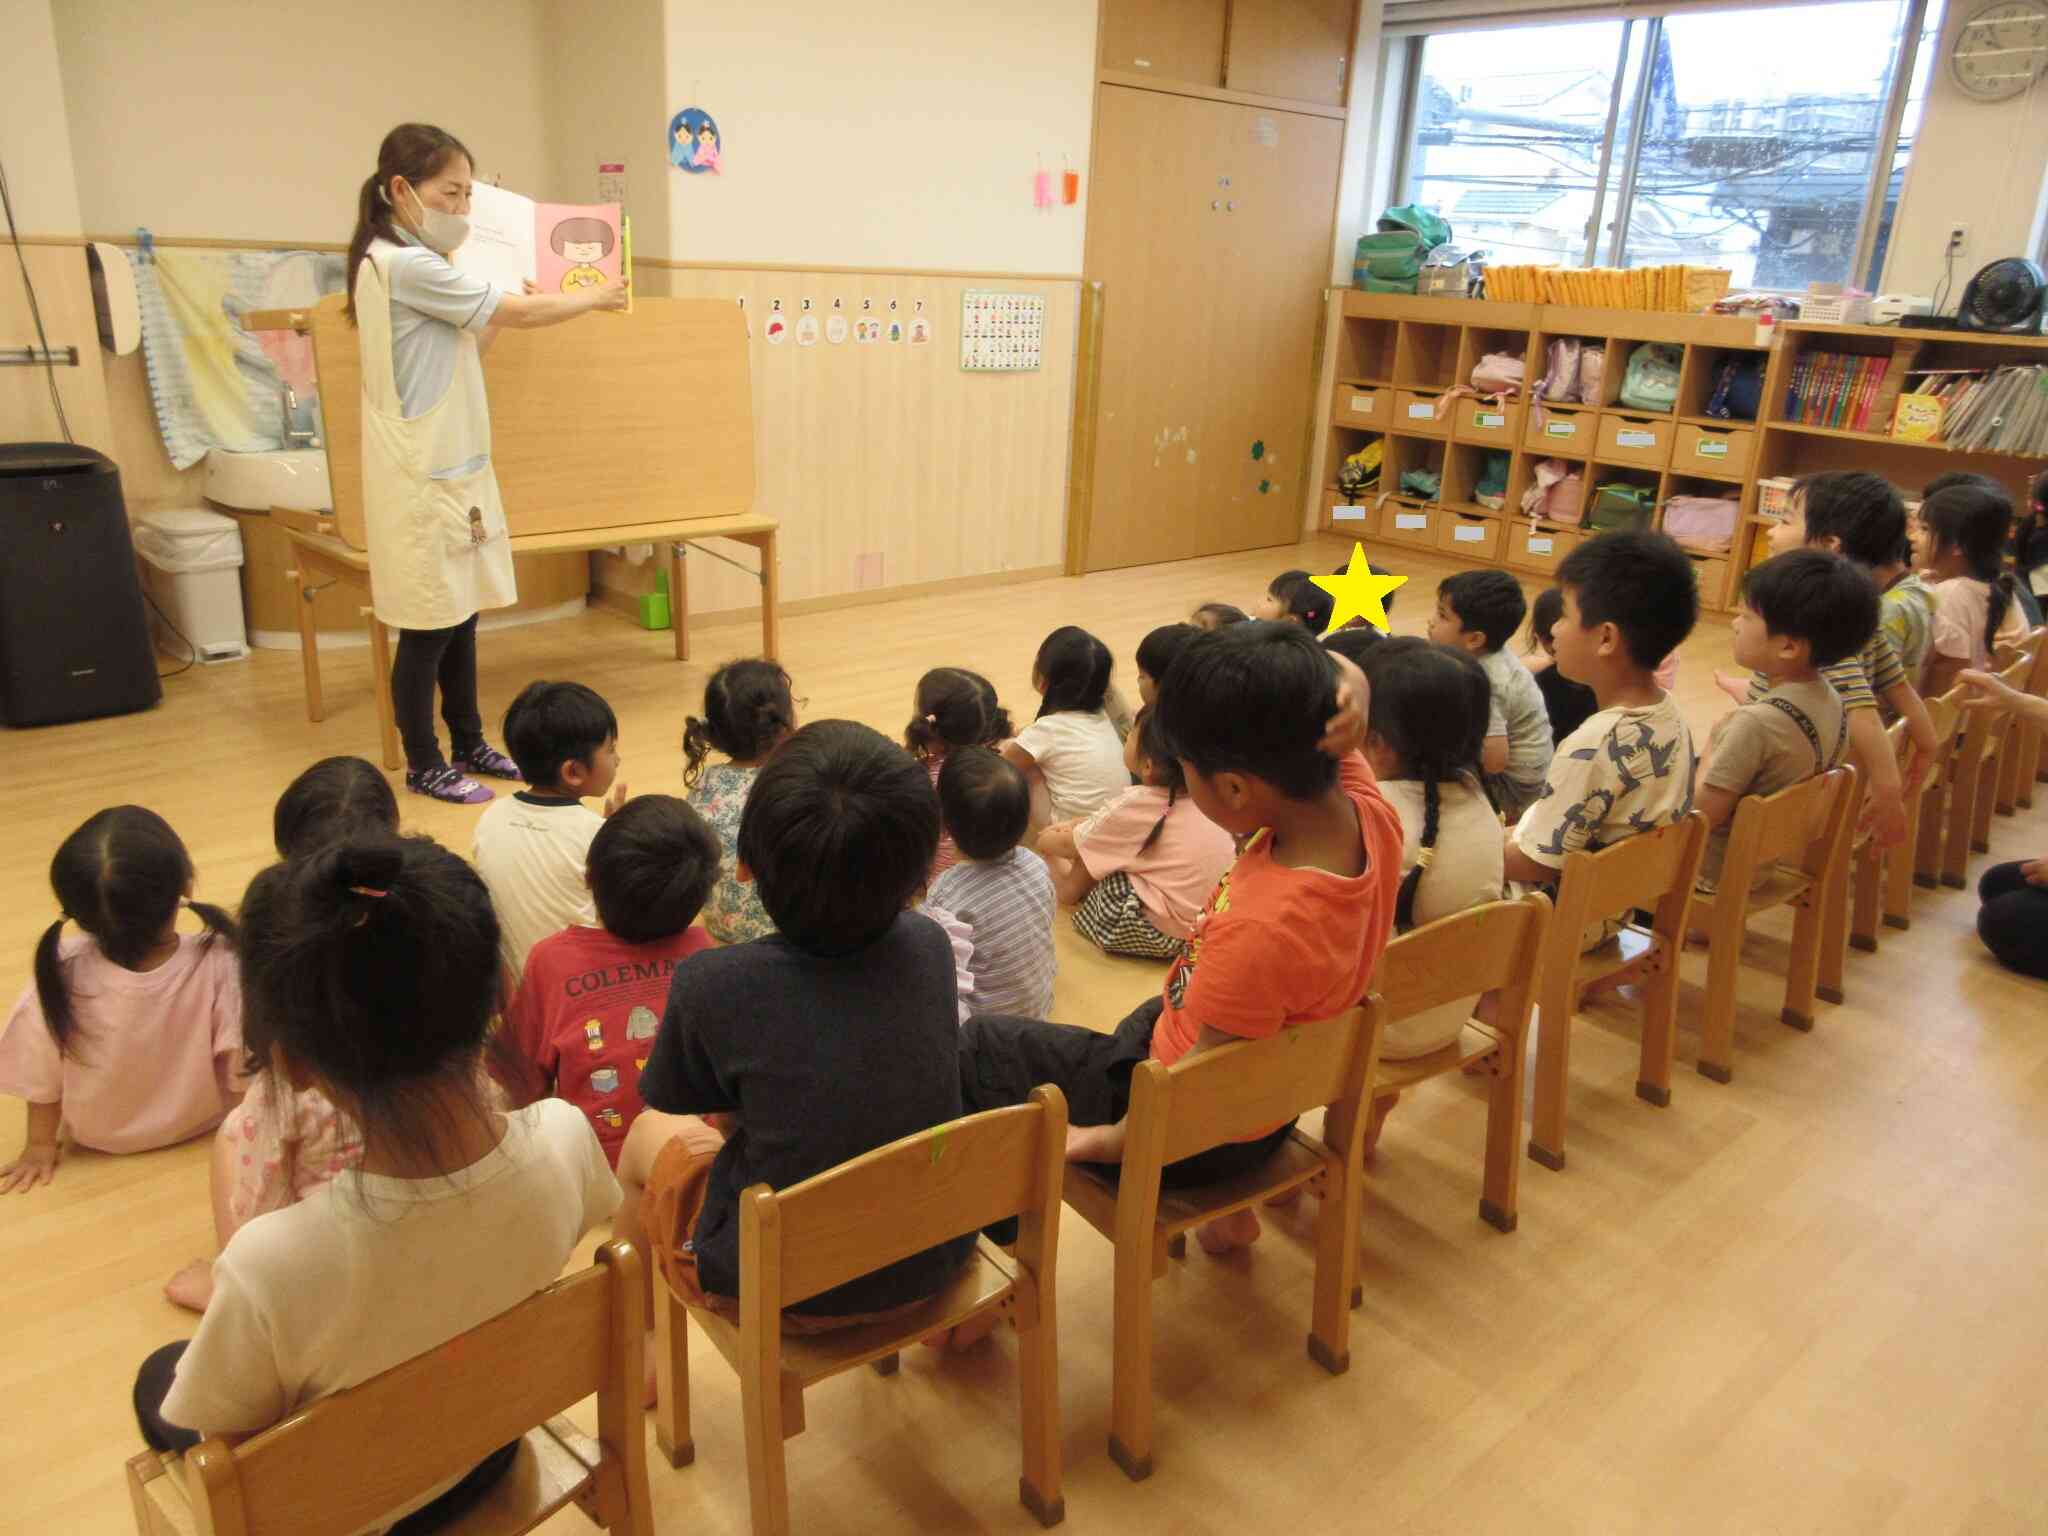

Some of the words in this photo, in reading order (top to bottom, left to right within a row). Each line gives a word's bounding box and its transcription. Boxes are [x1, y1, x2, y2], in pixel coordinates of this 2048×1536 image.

[774, 299, 780, 311] 2
[803, 299, 810, 310] 3
[834, 298, 840, 308] 4
[864, 299, 870, 310] 5
[890, 300, 897, 310] 6
[916, 301, 923, 311] 7
